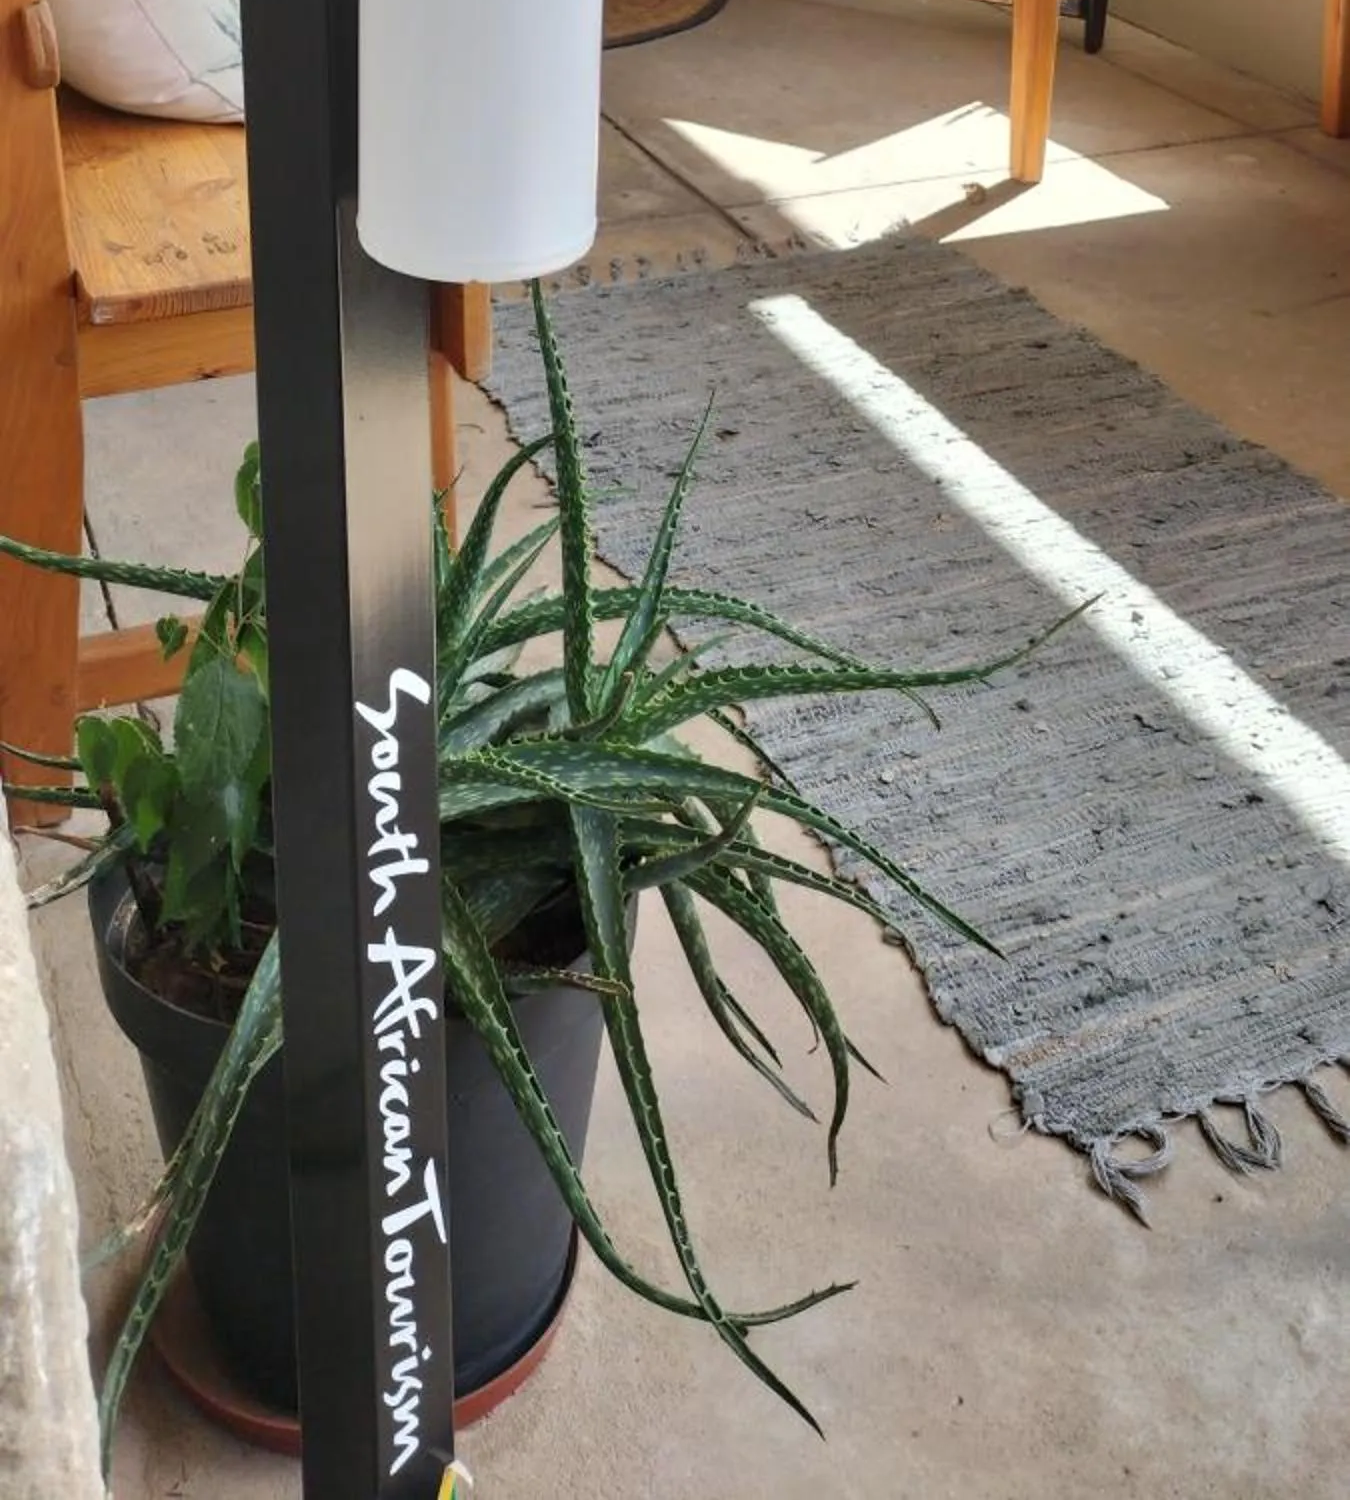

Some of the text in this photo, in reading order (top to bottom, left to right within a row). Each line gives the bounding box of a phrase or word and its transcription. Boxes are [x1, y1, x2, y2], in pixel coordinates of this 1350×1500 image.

[355, 668, 447, 1476] South African Tourism
